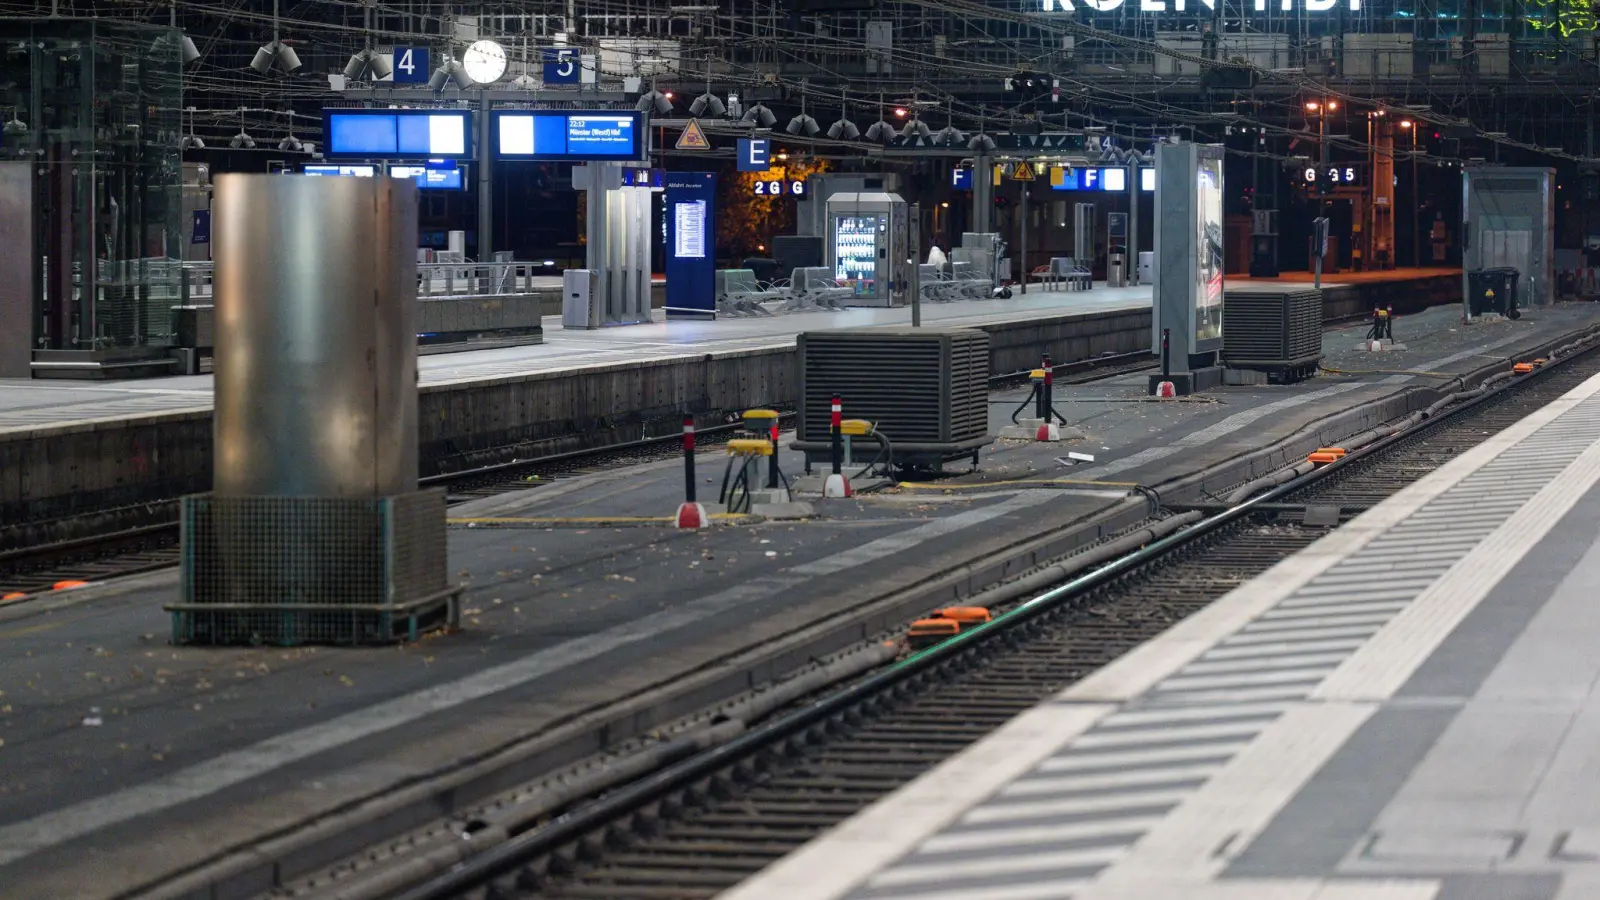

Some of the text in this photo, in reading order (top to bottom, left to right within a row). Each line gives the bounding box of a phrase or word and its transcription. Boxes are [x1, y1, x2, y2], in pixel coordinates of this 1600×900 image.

[398, 49, 415, 75] 4
[556, 50, 573, 77] 5
[750, 140, 765, 164] E
[954, 169, 964, 185] F
[1085, 169, 1097, 187] F
[1305, 168, 1316, 182] G
[1345, 168, 1354, 181] 5
[755, 181, 780, 195] 2 G
[792, 181, 803, 195] G
